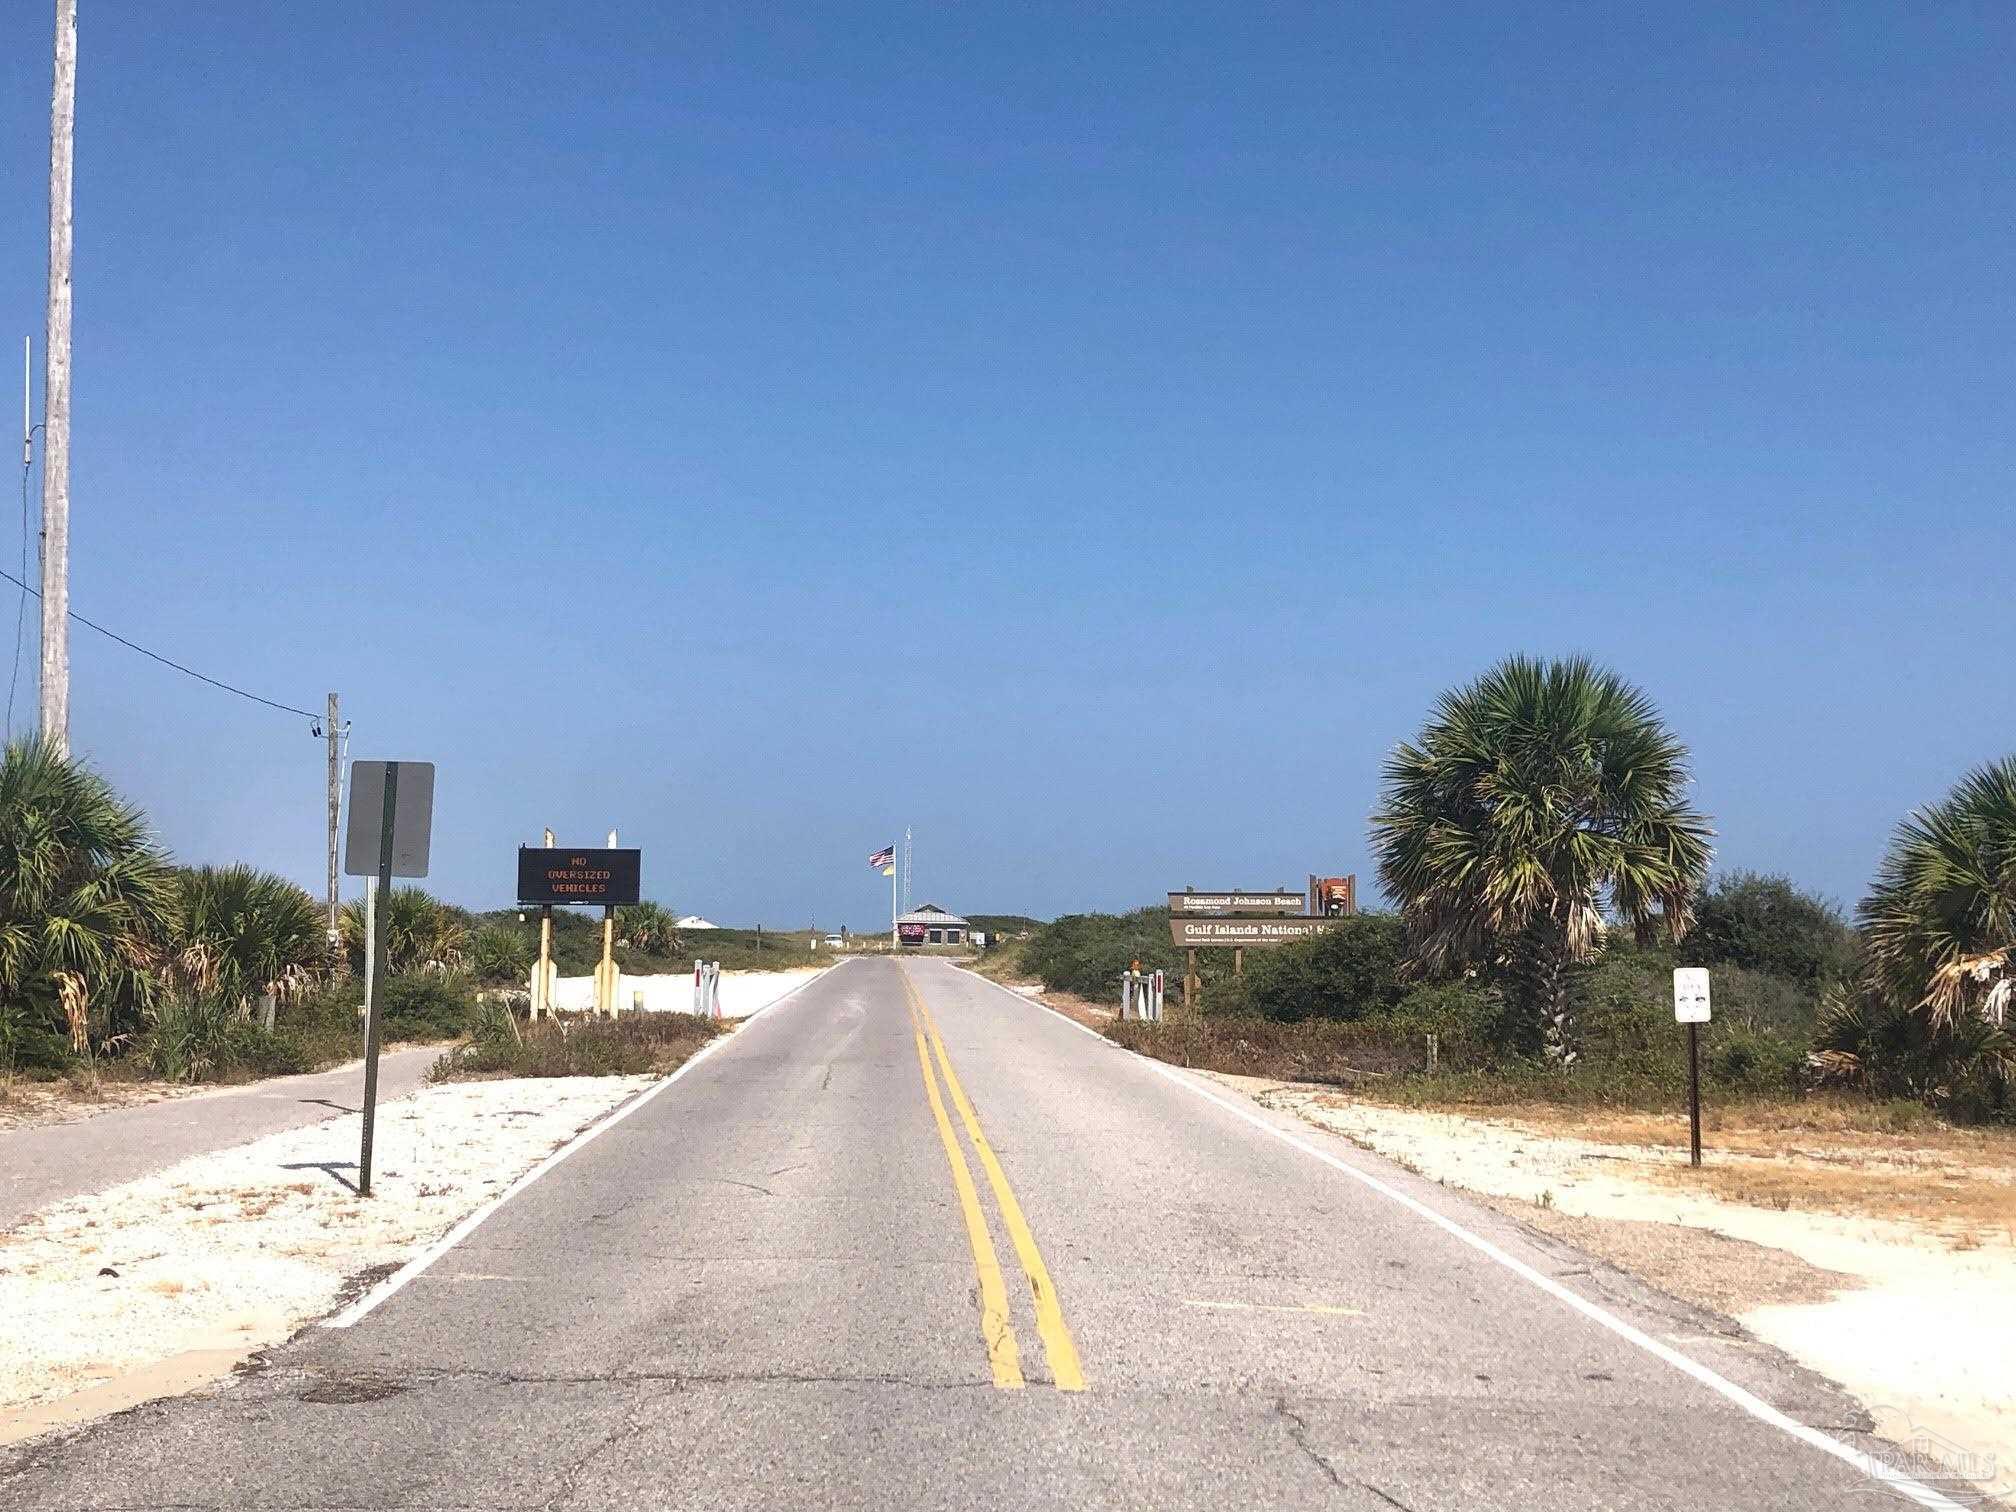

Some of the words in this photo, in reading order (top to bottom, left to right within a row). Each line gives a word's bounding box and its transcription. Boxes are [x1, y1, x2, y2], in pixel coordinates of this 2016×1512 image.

[571, 857, 587, 866] NO
[548, 870, 611, 880] OVERSIZED
[552, 883, 607, 893] VEHICLES
[1183, 896, 1231, 905] Rosamond
[1233, 897, 1272, 906] Johnson
[1274, 897, 1302, 906] Beach
[1184, 924, 1212, 935] Gulf
[1215, 924, 1260, 935] Islands
